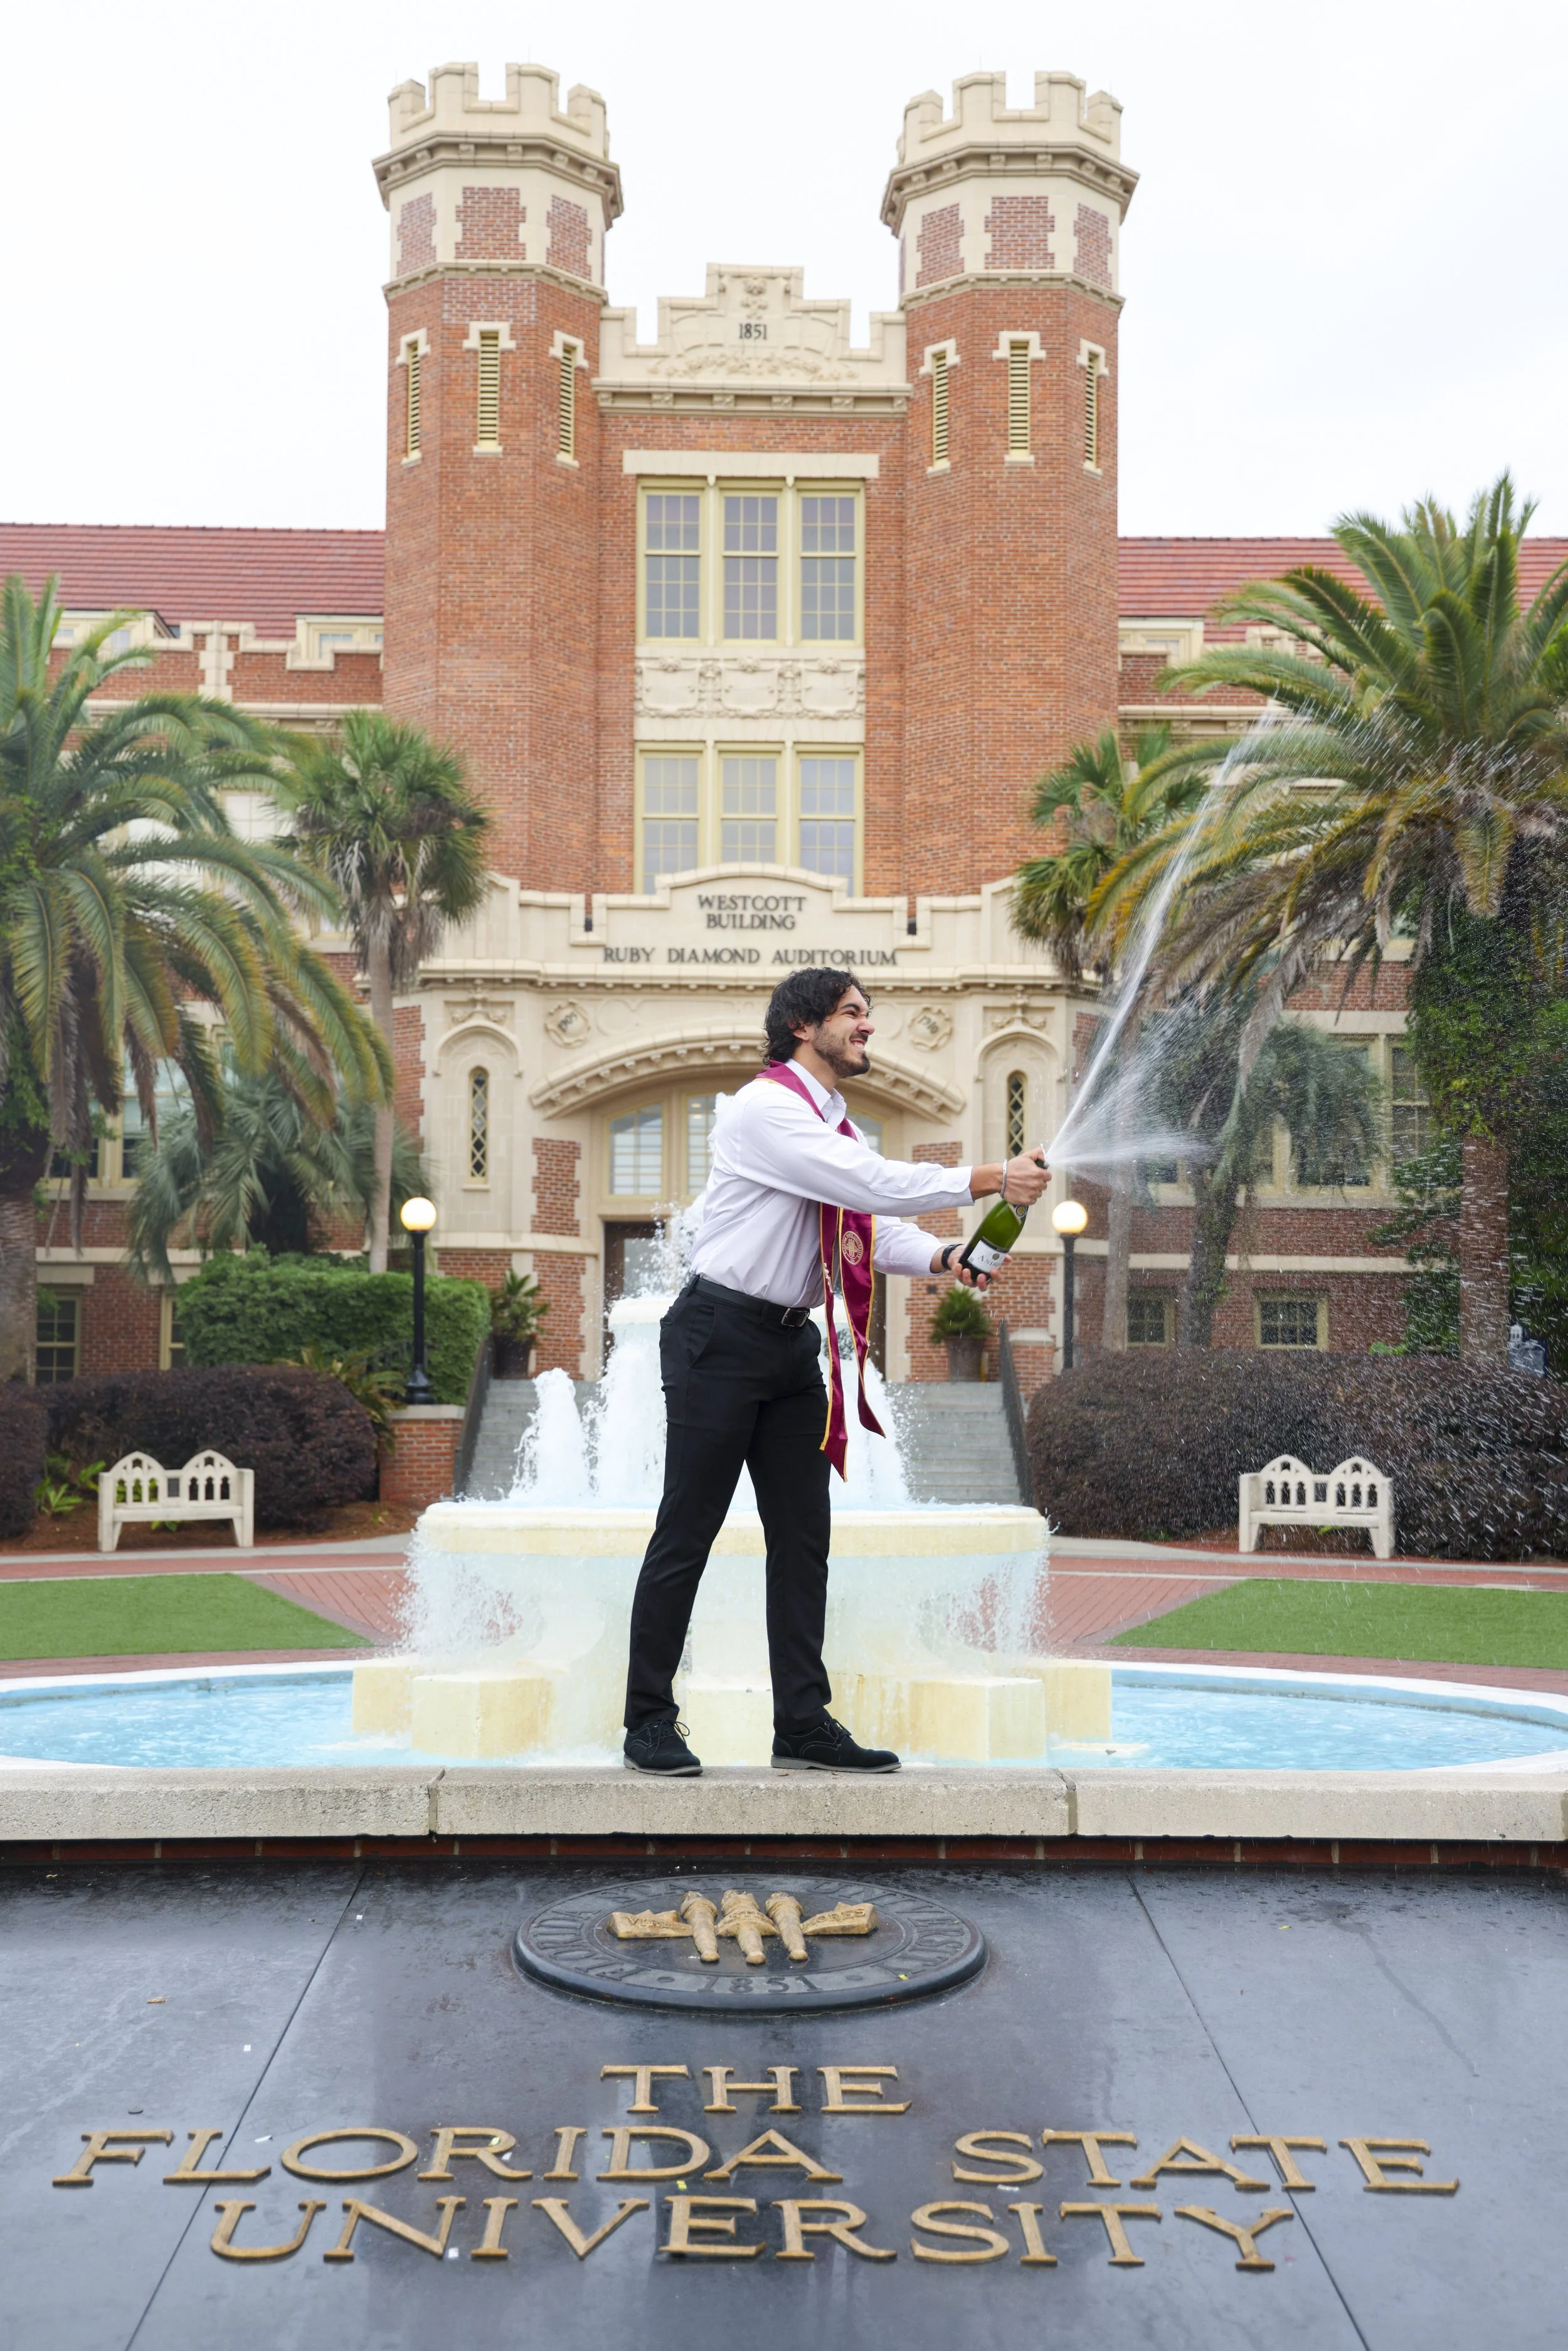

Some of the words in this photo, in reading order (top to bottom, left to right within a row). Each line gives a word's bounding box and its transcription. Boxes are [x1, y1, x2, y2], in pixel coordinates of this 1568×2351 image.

[739, 322, 767, 339] 1851
[698, 894, 806, 911] WESTCOTT
[707, 913, 796, 930] BUILDING
[603, 947, 655, 962] RUBY
[667, 948, 760, 964] DIAMOND
[771, 948, 898, 965] AUDITORIUM
[697, 1975, 823, 1993] 1851
[600, 2064, 912, 2115] THE
[52, 2126, 843, 2187] FLORIDA
[951, 2128, 1460, 2194] STATE
[209, 2194, 1295, 2273] UNIVERSITY
